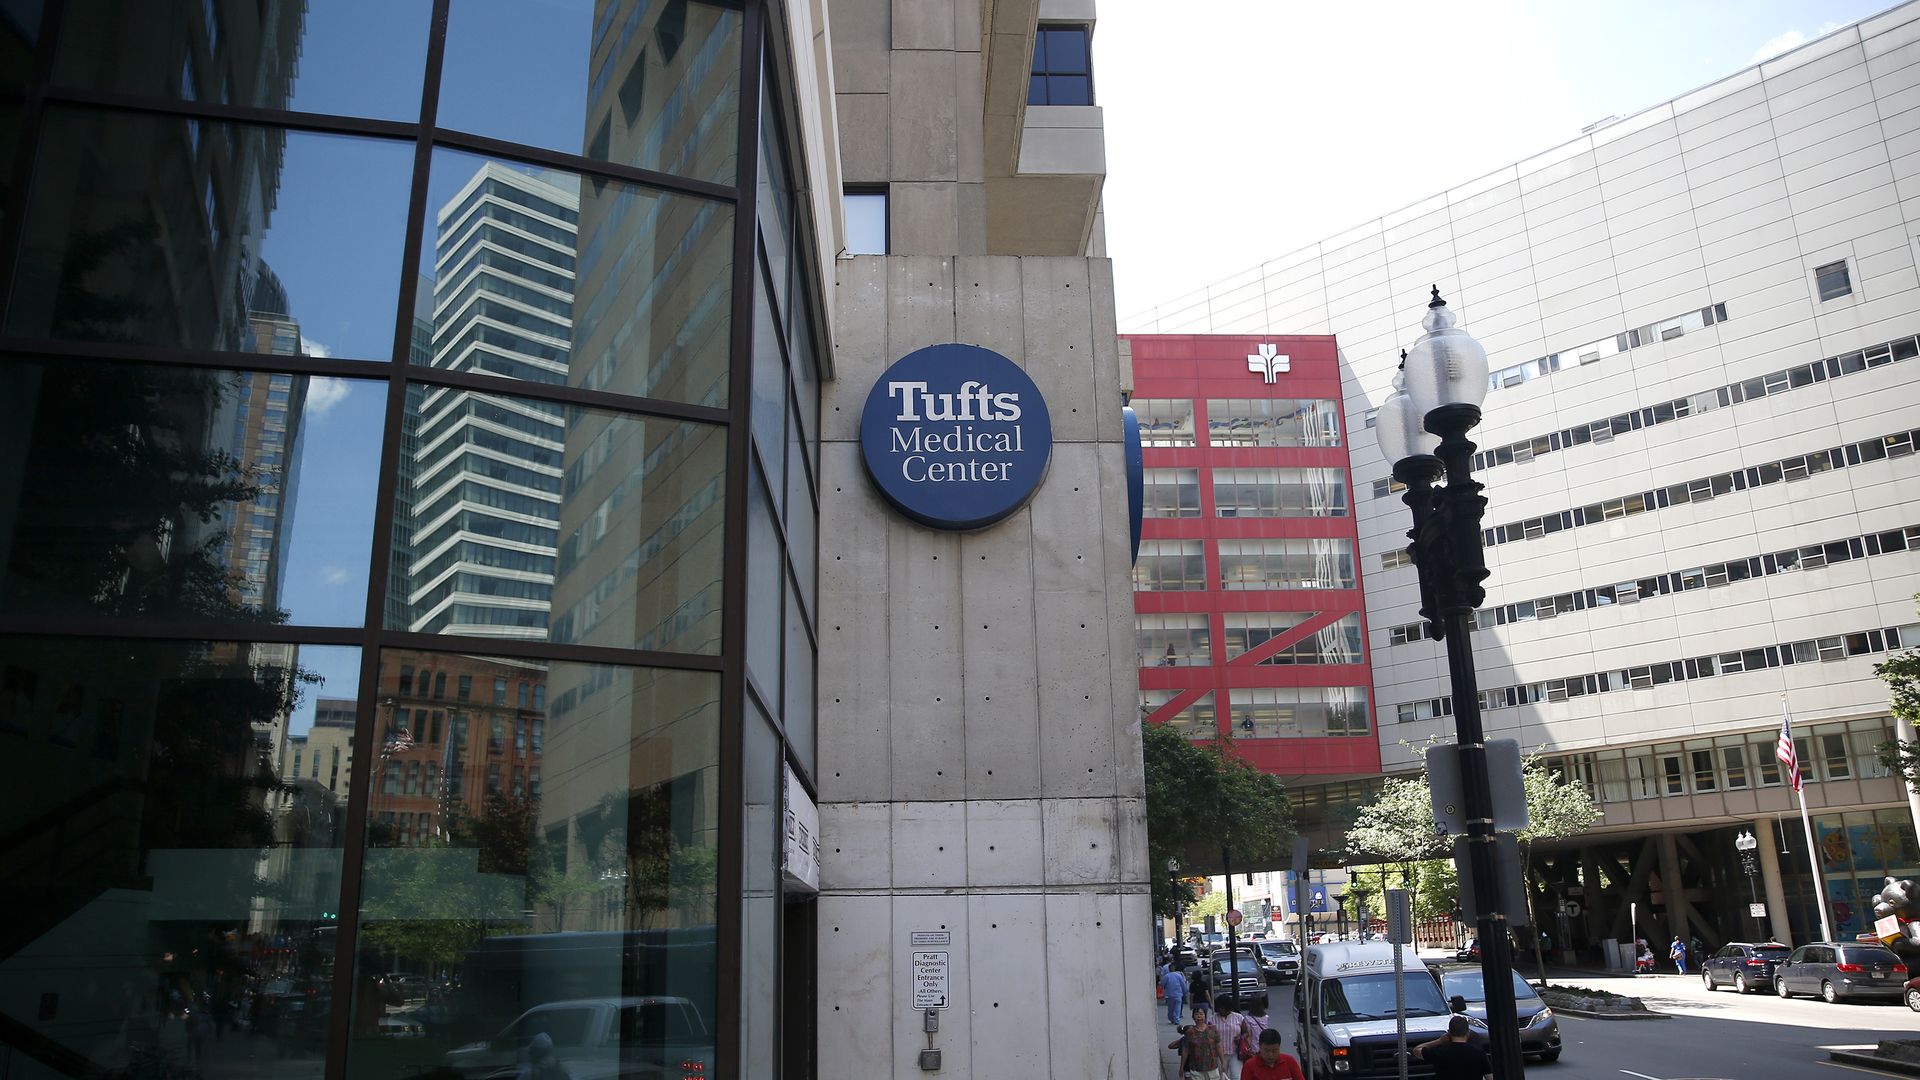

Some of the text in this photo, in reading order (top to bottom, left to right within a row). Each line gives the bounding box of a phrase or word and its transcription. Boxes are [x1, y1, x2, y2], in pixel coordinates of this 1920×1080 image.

[889, 381, 1022, 421] Tufts
[890, 425, 1024, 453] Medical
[902, 456, 1013, 482] Center
